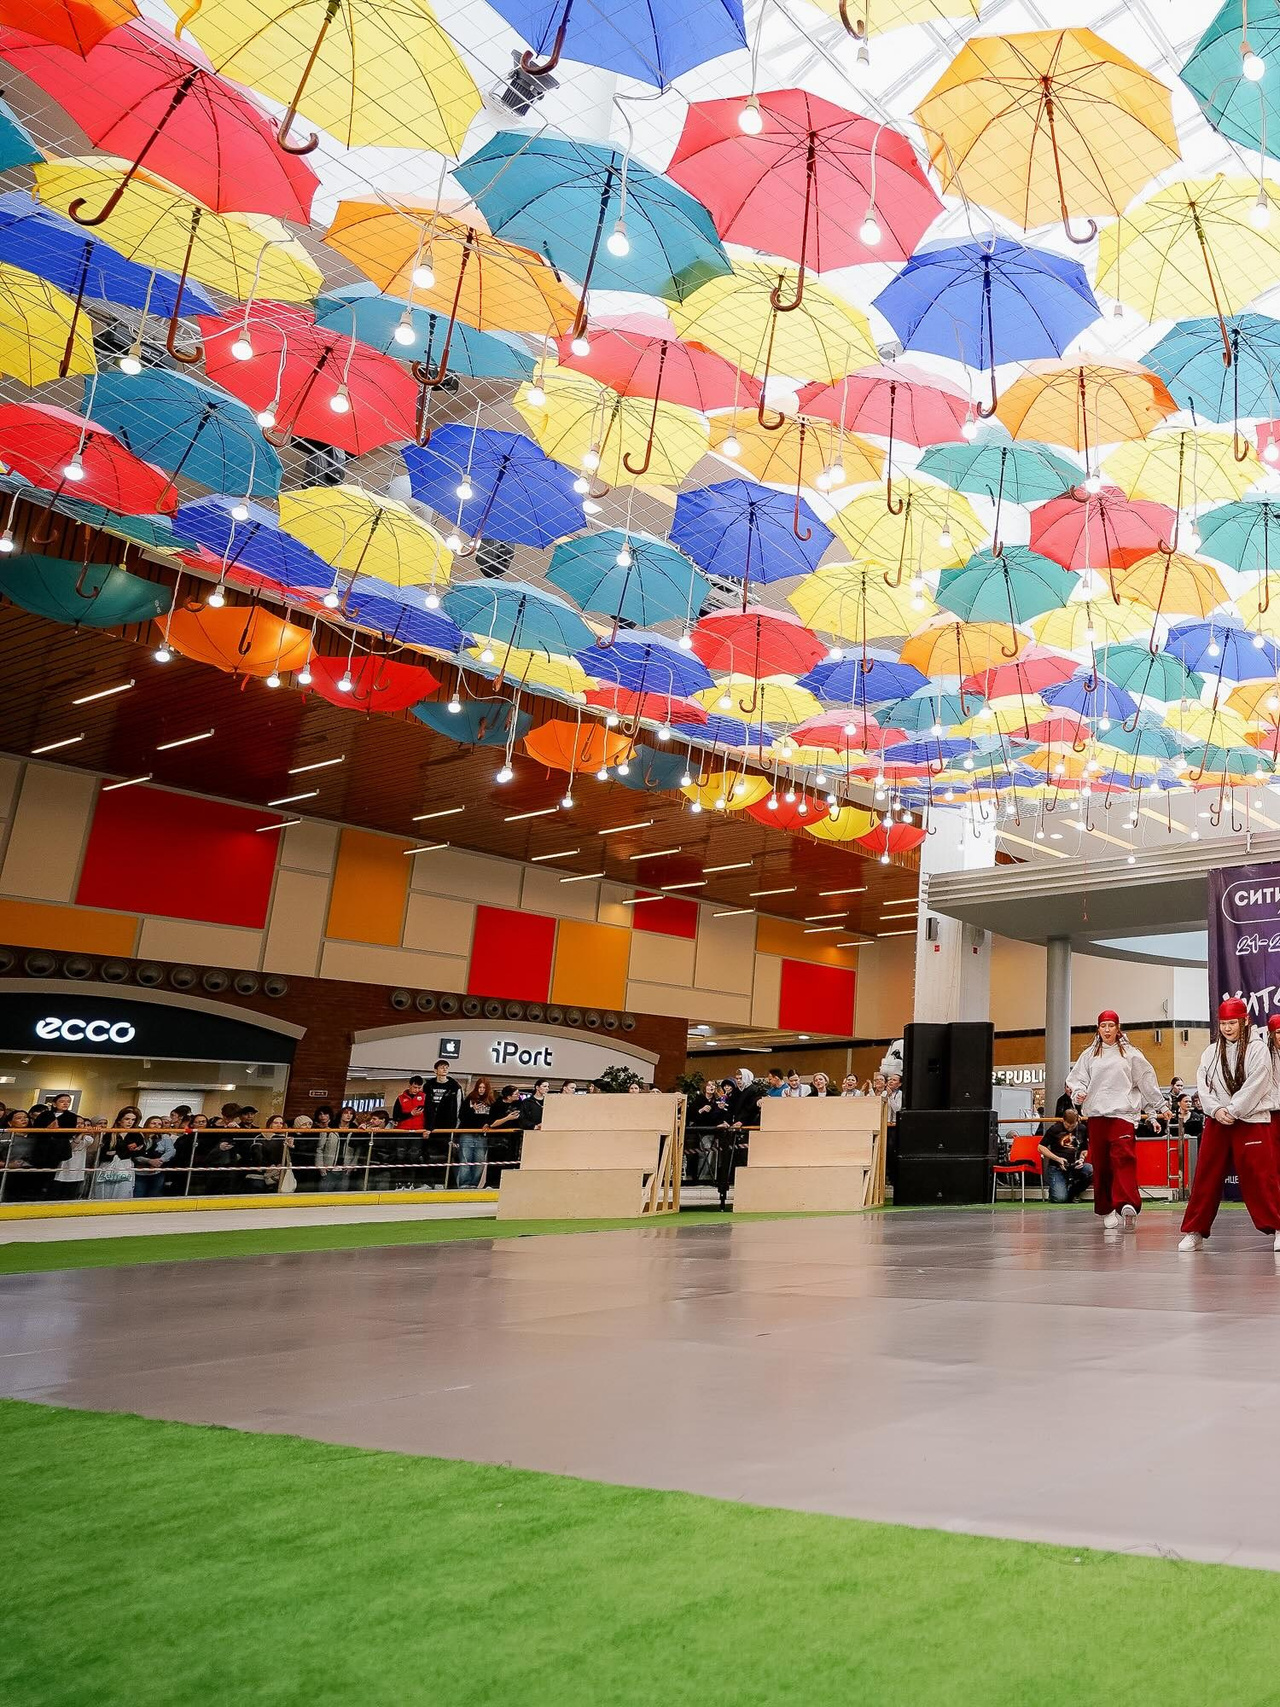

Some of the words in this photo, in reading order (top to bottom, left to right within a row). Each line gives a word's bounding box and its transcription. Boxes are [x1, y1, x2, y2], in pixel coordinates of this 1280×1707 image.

[35, 1017, 136, 1044] ecco
[491, 1040, 553, 1067] iPort
[992, 1069, 1046, 1085] REPUBLI
